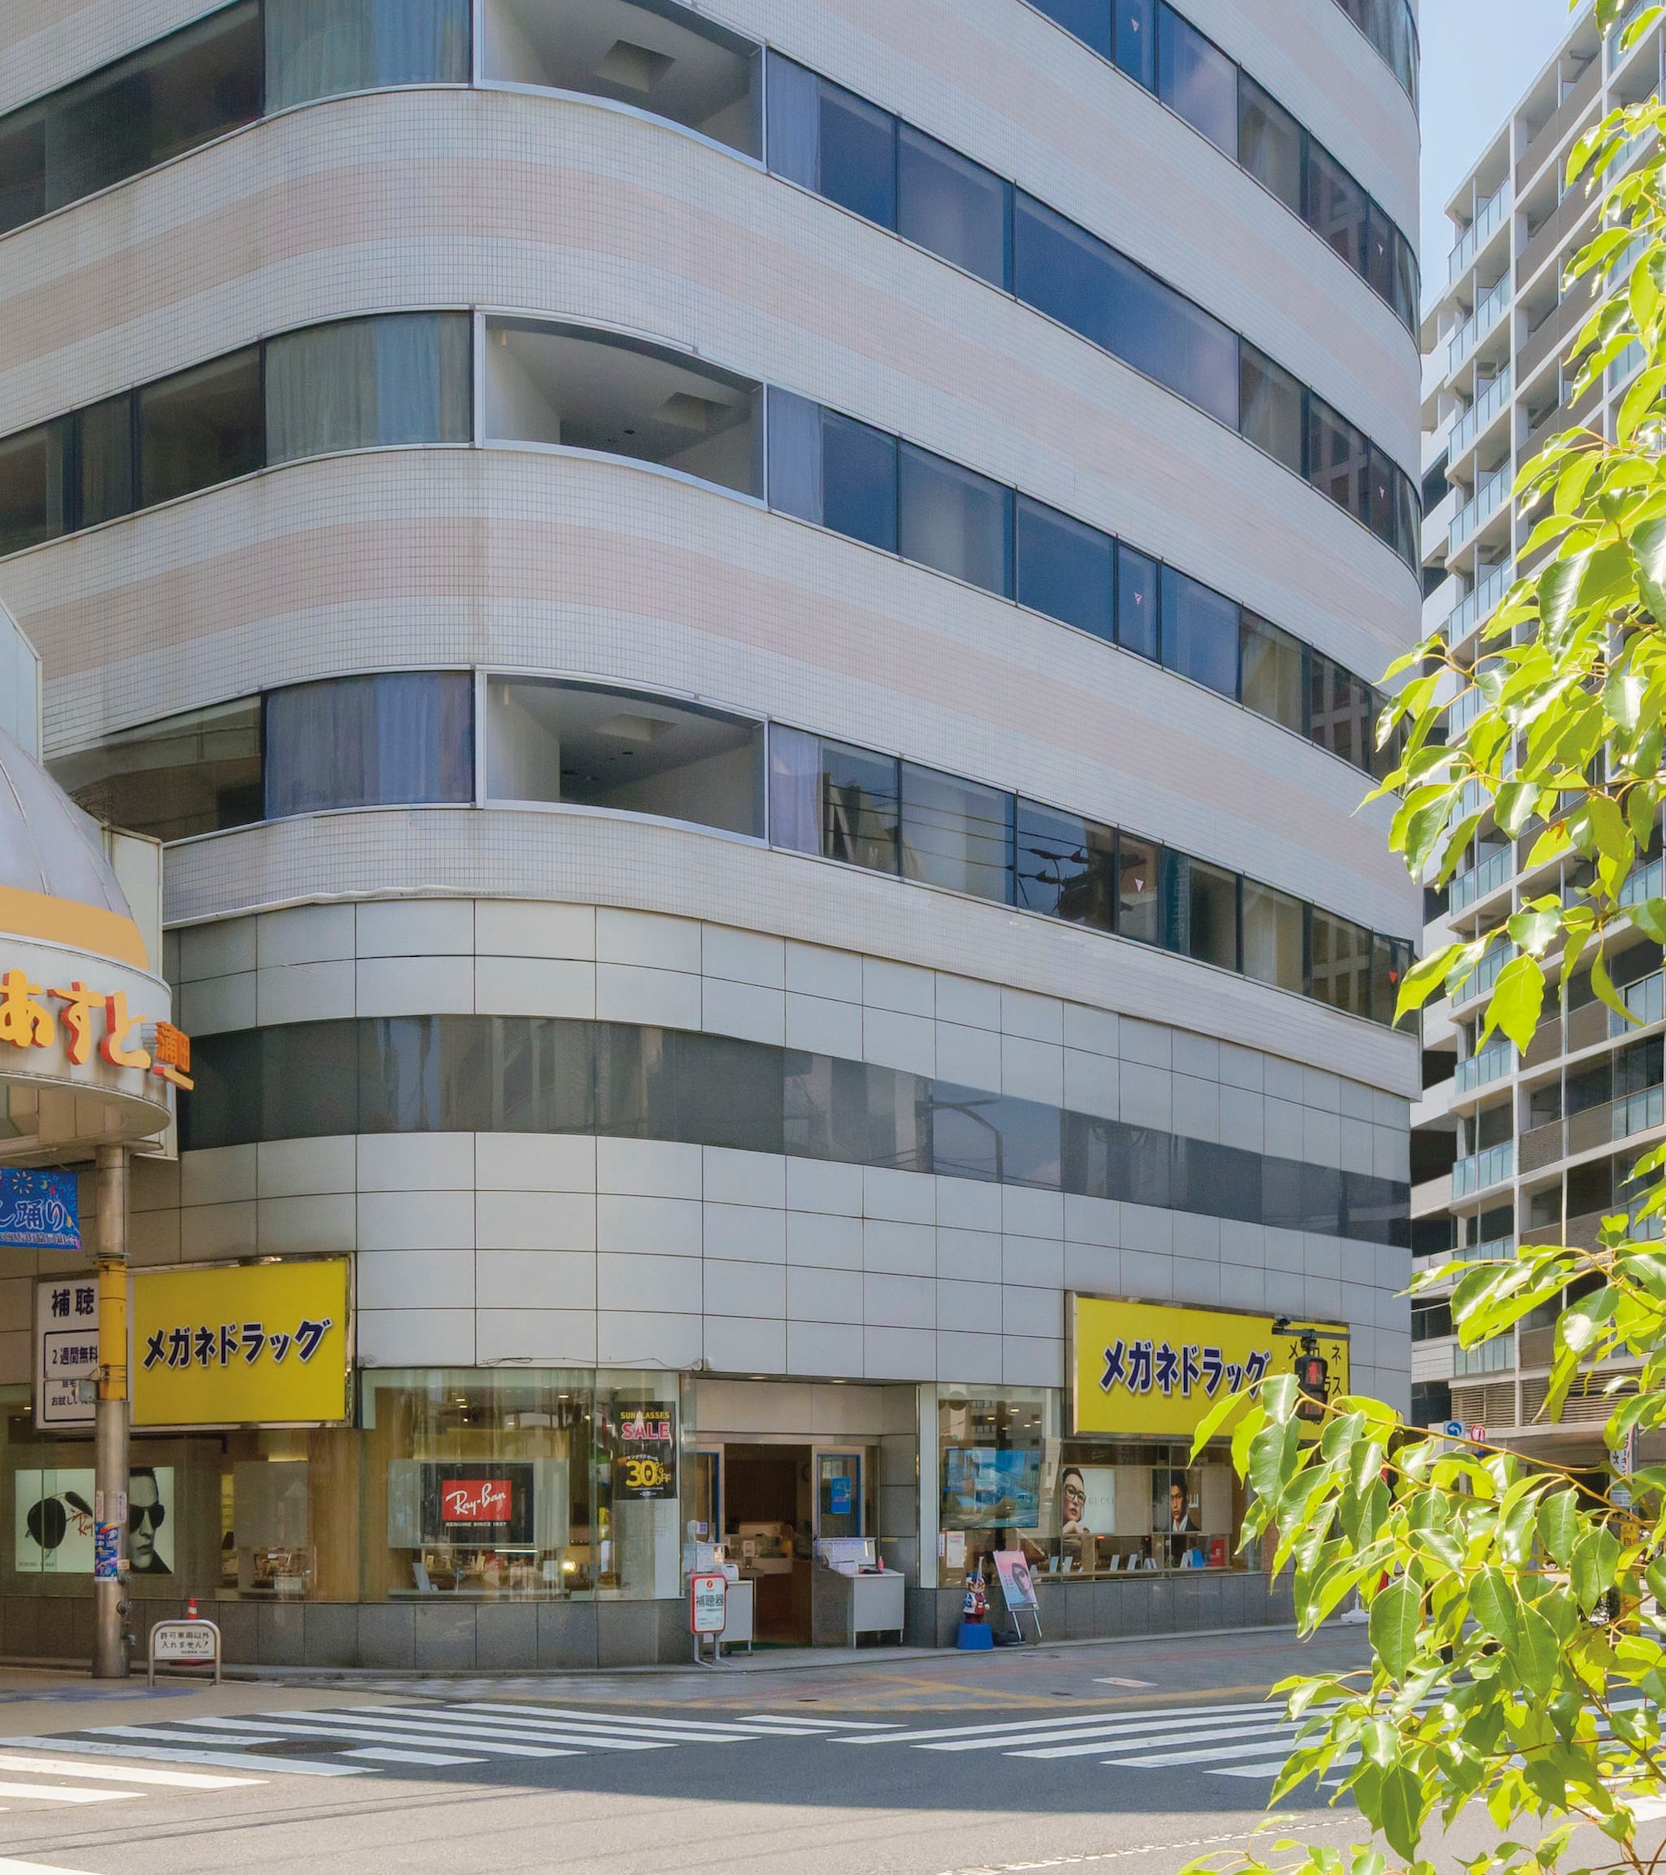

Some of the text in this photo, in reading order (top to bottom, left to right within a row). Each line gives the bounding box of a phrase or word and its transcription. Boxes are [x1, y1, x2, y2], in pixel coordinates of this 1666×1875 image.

[143, 1317, 333, 1371] メガネドラッグ
[1099, 1337, 1272, 1401] メガネドラッグ
[621, 1421, 670, 1440] SALE
[445, 1482, 507, 1515] Ray-Ban
